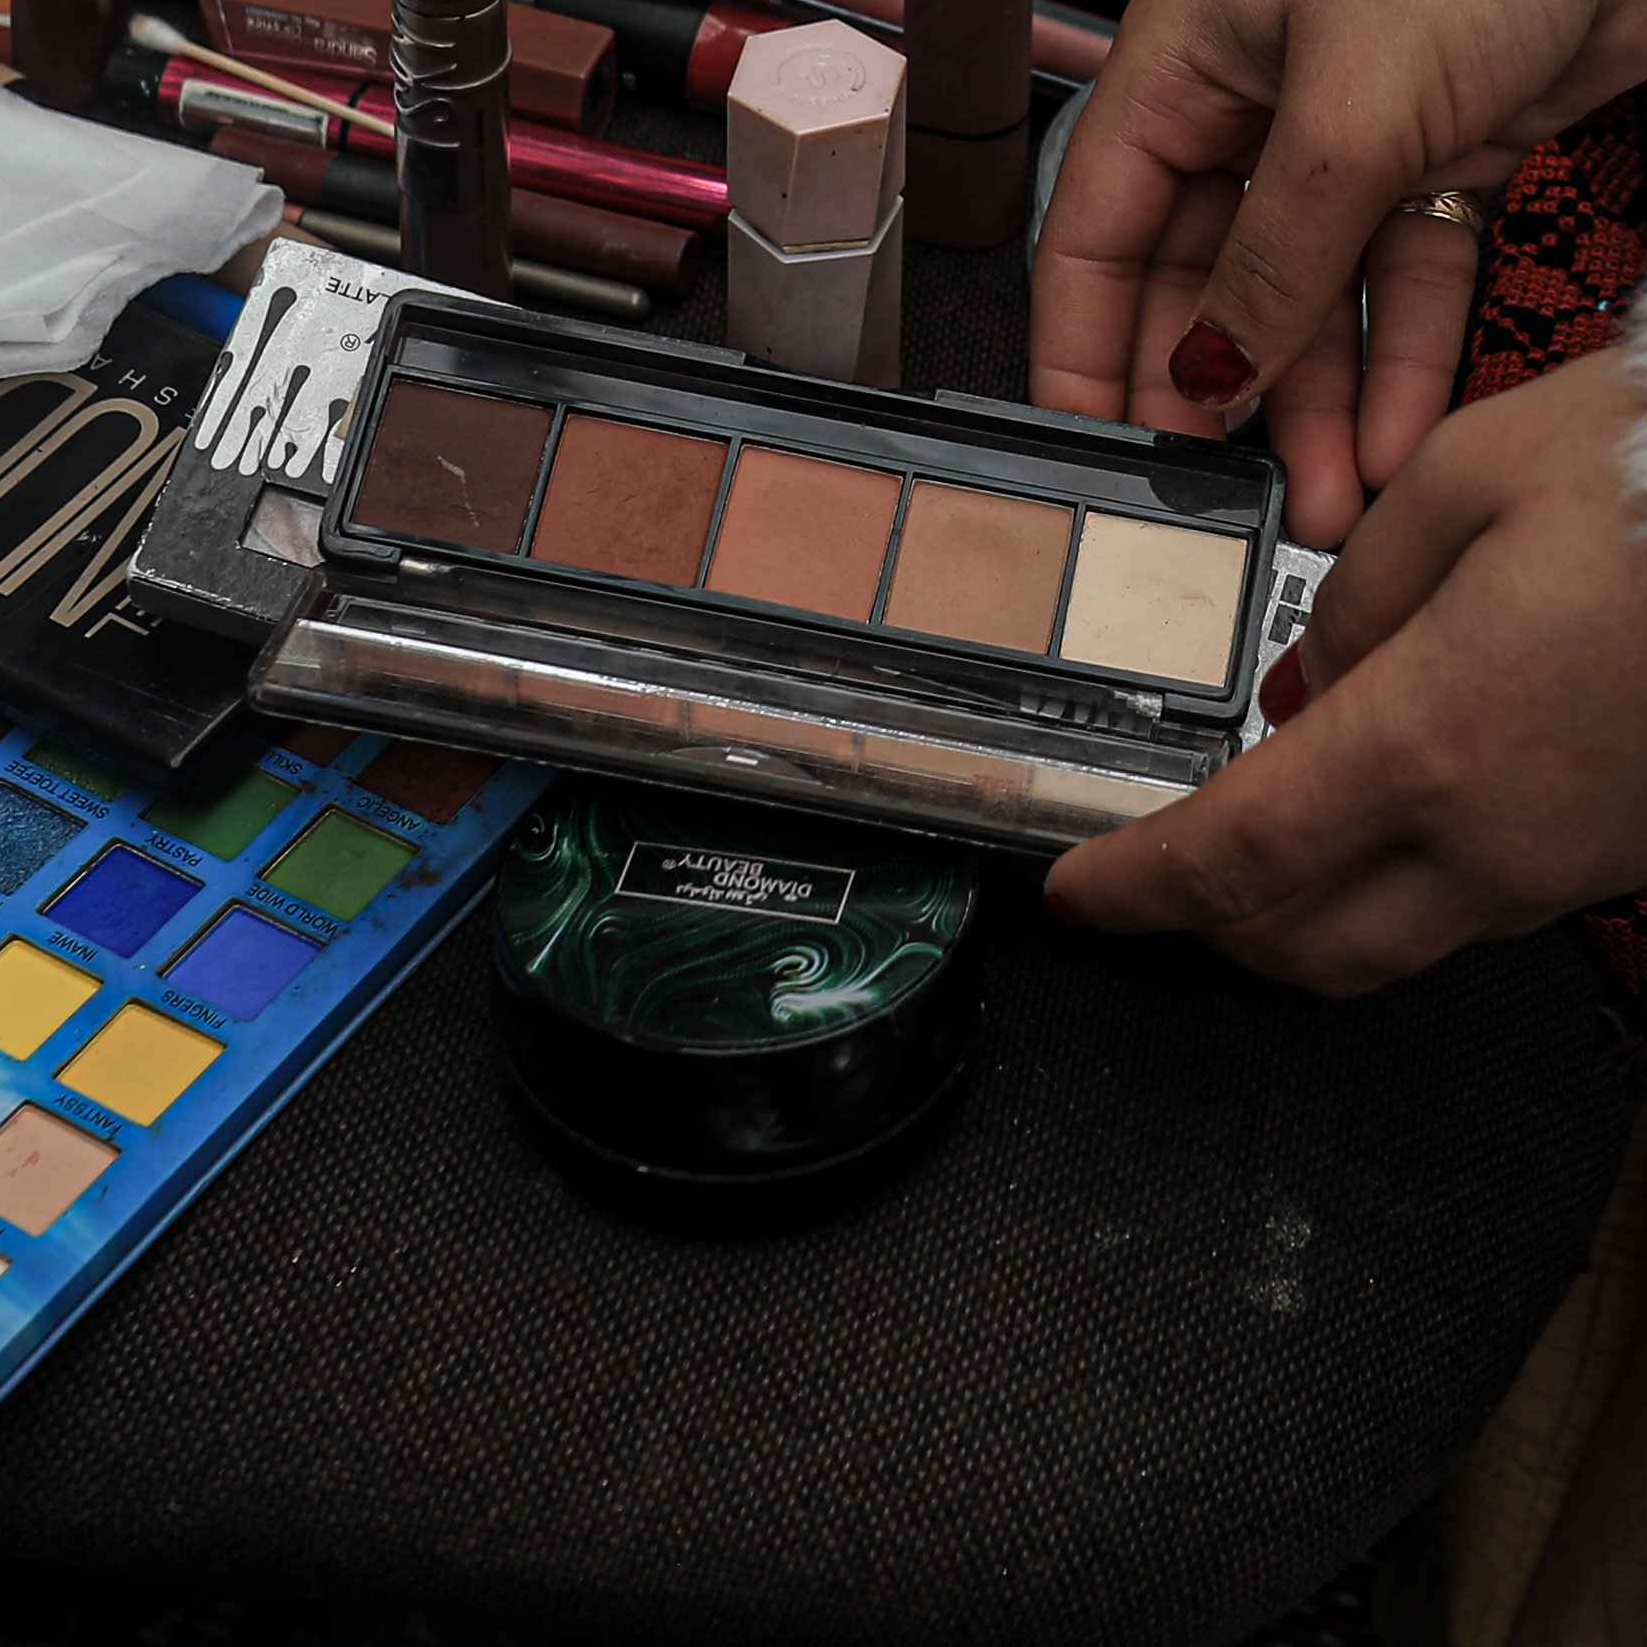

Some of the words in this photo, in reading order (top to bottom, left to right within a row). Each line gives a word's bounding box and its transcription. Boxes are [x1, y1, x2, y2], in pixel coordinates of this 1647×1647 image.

[313, 37, 377, 67] Sandra
[89, 353, 179, 406] SHA
[257, 749, 303, 775] SKILL
[57, 788, 110, 820] SWEET
[356, 796, 421, 832] ANGELIC
[144, 835, 203, 867] PASTRY
[245, 884, 287, 910] WIDE
[712, 870, 813, 898] DIAMOND
[284, 902, 340, 937] WORLD
[46, 930, 97, 962] INAWE
[159, 989, 227, 1030] FINGERS
